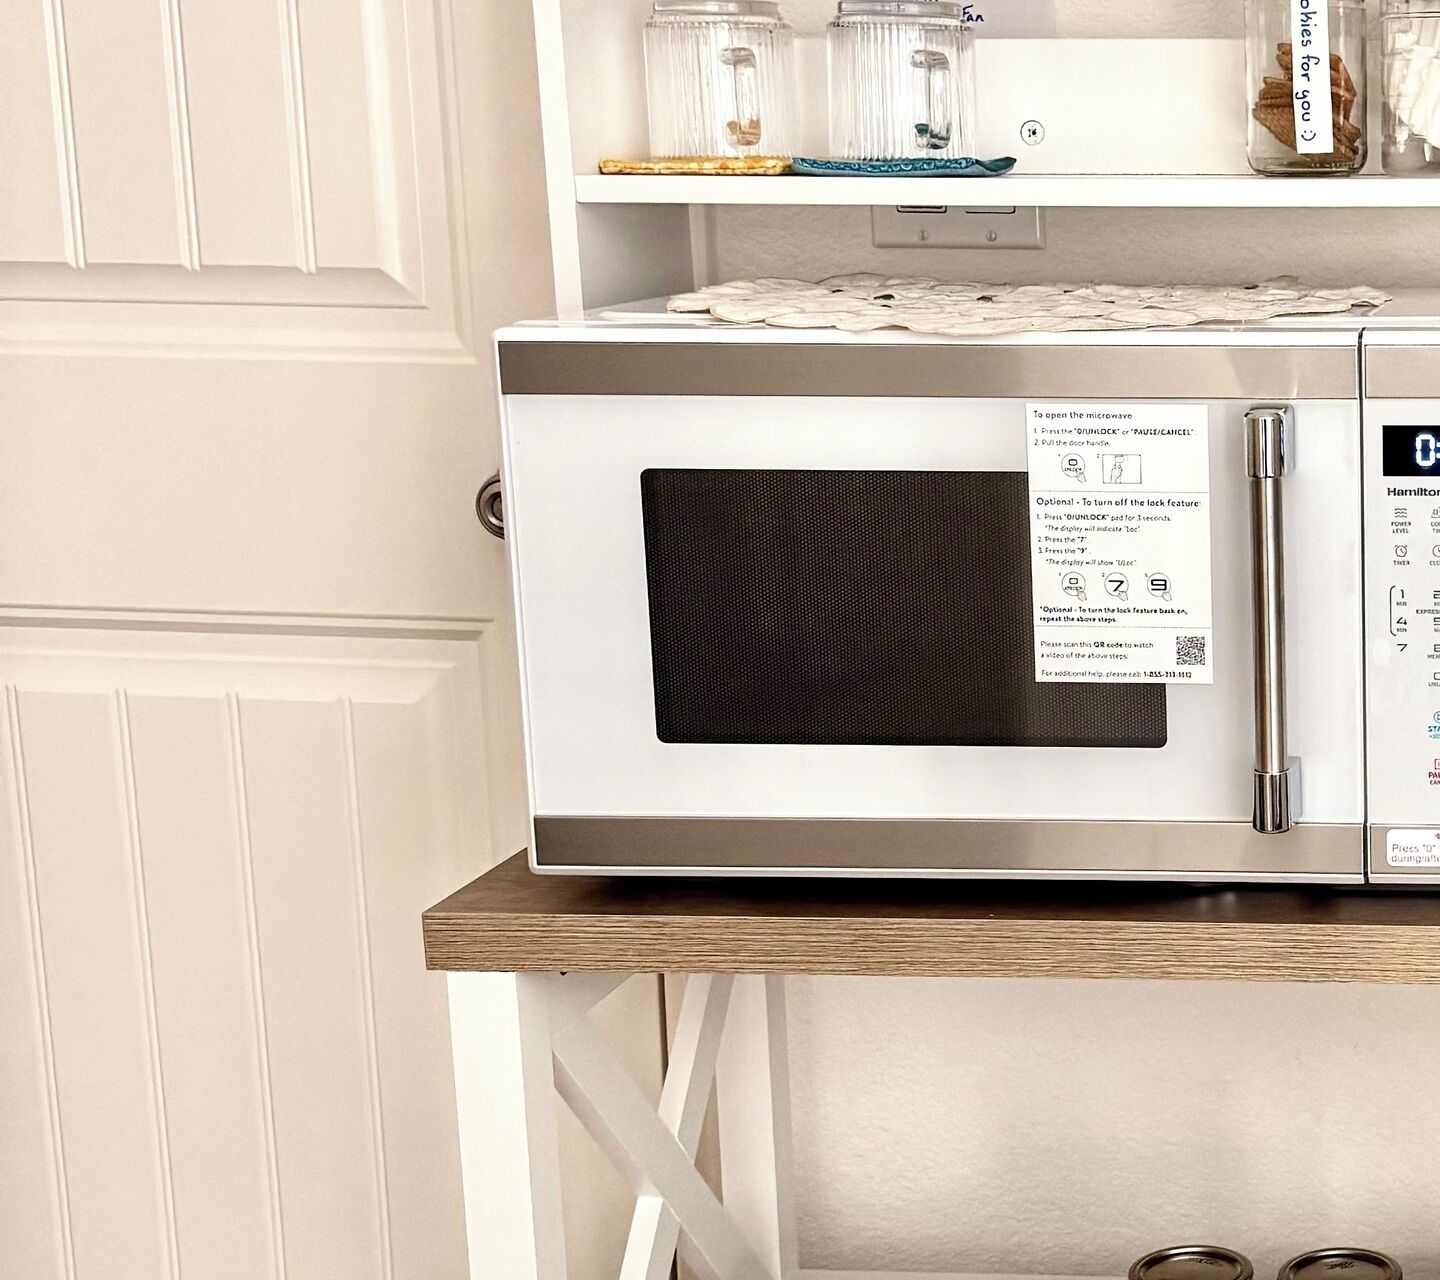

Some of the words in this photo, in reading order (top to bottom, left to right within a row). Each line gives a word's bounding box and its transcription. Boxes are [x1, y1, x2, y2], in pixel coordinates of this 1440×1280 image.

[963, 5, 985, 22] Fan
[1301, 55, 1320, 83] for
[1295, 88, 1312, 123] you
[1034, 410, 1043, 419] To
[1087, 411, 1133, 420] microwave
[1036, 497, 1074, 507] Optional
[1082, 498, 1092, 506] To
[1115, 498, 1128, 506] off
[1131, 499, 1145, 507] the
[1147, 499, 1166, 507] lock
[1167, 499, 1202, 507] feature:
[1061, 559, 1084, 567] display
[1108, 580, 1125, 592] 7
[1151, 579, 1168, 591] 9
[1400, 589, 1405, 599] 1
[1396, 617, 1408, 626] 4
[1396, 644, 1408, 653] 7
[1392, 844, 1420, 853] Press
[1423, 844, 1437, 853] "0"
